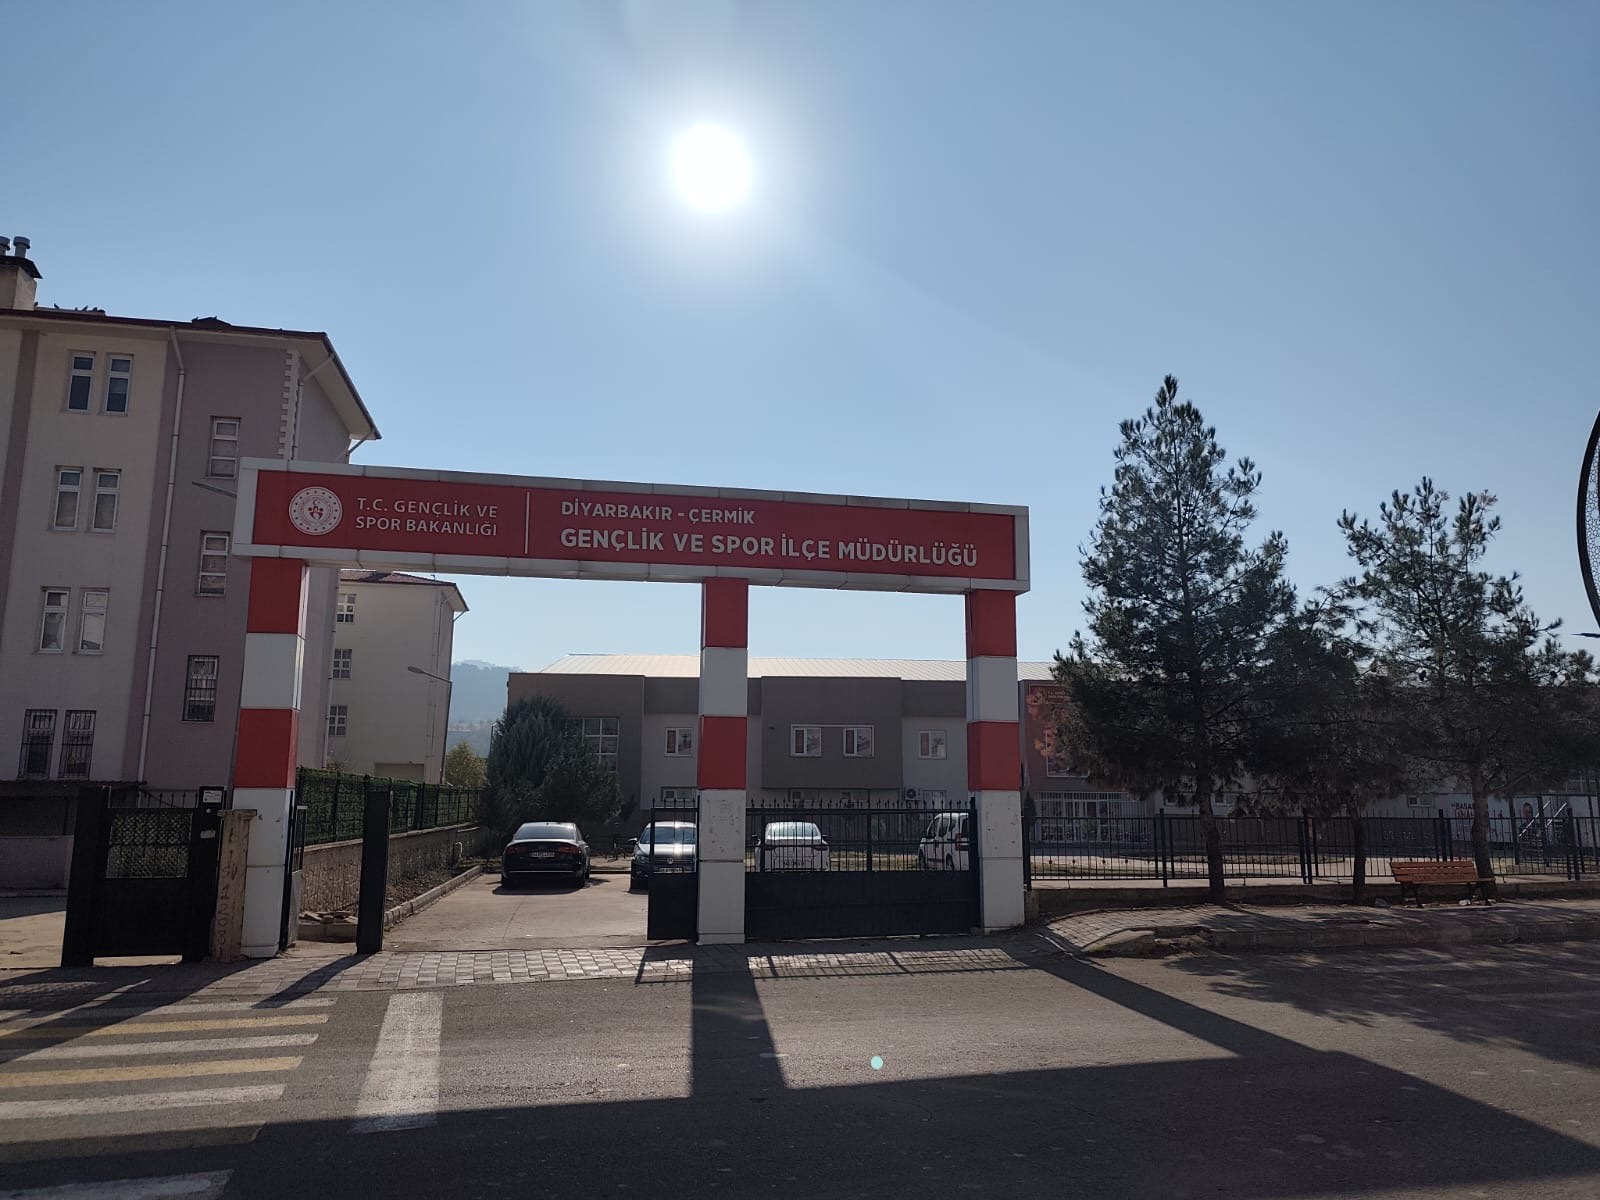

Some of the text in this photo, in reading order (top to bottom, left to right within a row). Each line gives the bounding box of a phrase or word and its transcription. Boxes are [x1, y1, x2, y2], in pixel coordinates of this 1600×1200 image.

[357, 498, 498, 518] T.C. GENÇLİK VE
[561, 499, 673, 521] DİYARBAKIR
[688, 507, 755, 524] ÇERMİK
[355, 516, 497, 536] SPOR BAKANLIĞI
[560, 527, 977, 567] GENÇLİK VE SPOR İLÇE MÜDÜRLÜĞÜ
